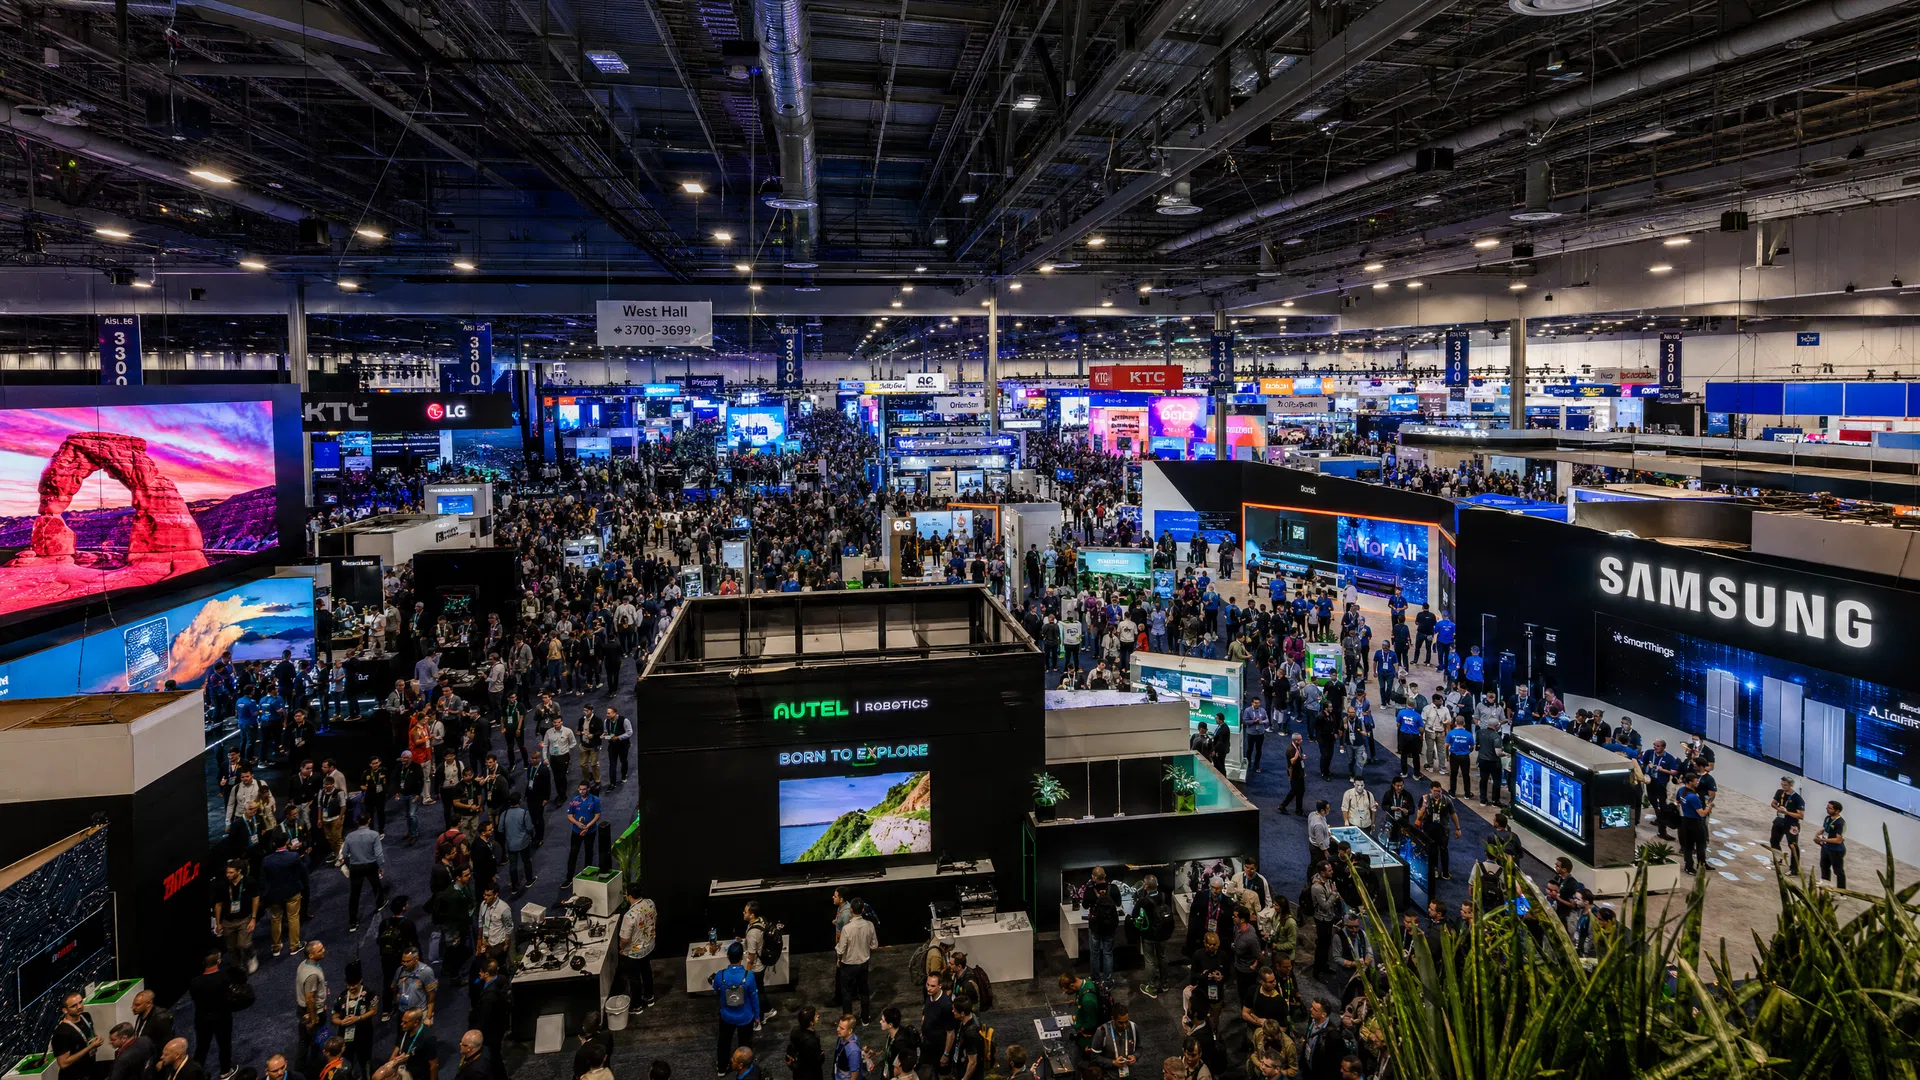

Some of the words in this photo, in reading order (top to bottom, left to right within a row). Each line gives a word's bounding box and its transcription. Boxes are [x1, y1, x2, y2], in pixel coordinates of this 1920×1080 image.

[623, 305, 657, 318] West
[662, 305, 688, 318] Hall
[625, 325, 691, 335] 3700-3699
[470, 336, 481, 386] 3300
[1454, 341, 1462, 382] 3300
[1667, 343, 1675, 383] 3300
[1130, 371, 1166, 383] KTC
[446, 405, 466, 418] LG
[1344, 534, 1359, 552] AI
[1363, 537, 1389, 556] for
[1393, 542, 1417, 562] All
[1600, 556, 1872, 649] SAMSUNG
[1623, 635, 1675, 658] SmartThings
[774, 700, 849, 719] AUTEL
[865, 699, 929, 712] ROBOTICS
[779, 750, 826, 765] BORN
[831, 748, 852, 761] TO
[856, 743, 929, 760] EXPLORE
